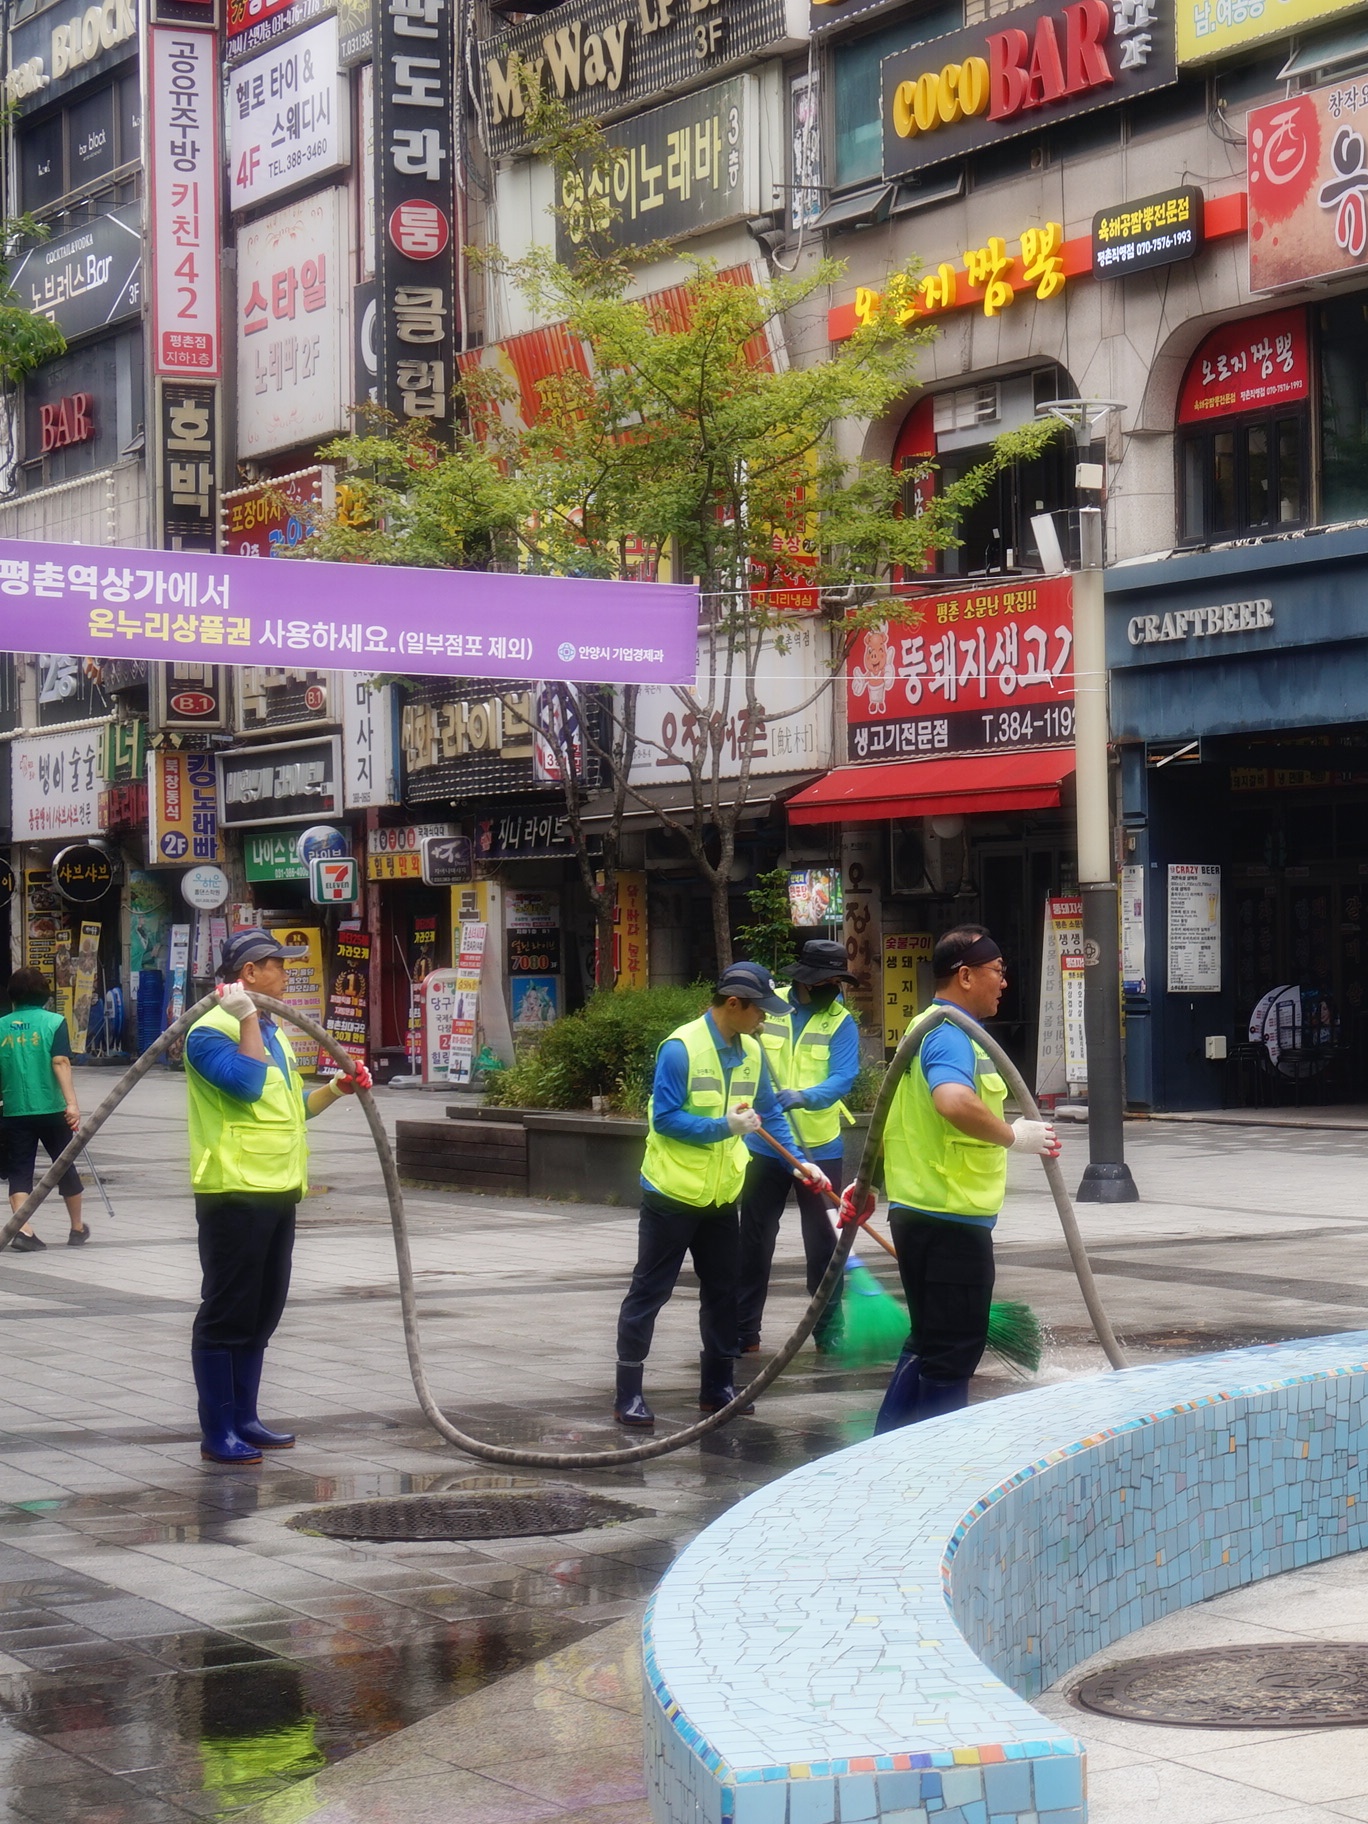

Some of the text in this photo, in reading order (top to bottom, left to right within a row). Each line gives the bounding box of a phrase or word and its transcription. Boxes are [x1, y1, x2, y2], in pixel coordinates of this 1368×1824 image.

[543, 19, 632, 99] Way
[694, 16, 722, 59] 3F
[236, 73, 266, 120] 헬로
[270, 54, 298, 100] 타이
[892, 0, 1115, 138] COCO BAR
[270, 87, 331, 148] 스웨디시
[168, 41, 200, 319] 공유주방 키친42
[236, 144, 260, 190] 4F
[399, 206, 440, 252] 룸
[1098, 196, 1190, 242] 육해공짬뽕전문점
[1097, 230, 1192, 267] 평촌직영점 070-7576-1993
[128, 282, 140, 305] 3F
[243, 252, 327, 336] 스타일
[166, 352, 210, 365] 지하1층
[169, 335, 207, 349] 평촌점
[1202, 332, 1294, 386] 오로지 짬뽕
[40, 392, 95, 452] BAR
[0, 559, 230, 609] 평촌역상가에서
[936, 589, 1037, 624] 평촌 소문난 맛집!!
[88, 608, 534, 661] 온누리상품권 사용하세요. (일부점포 제외)
[1127, 598, 1274, 646] CRAFTBEER
[578, 645, 665, 663] 안양시 기업경제과
[854, 718, 949, 756] 생고기전문점
[165, 759, 180, 820] 북창동식
[163, 833, 187, 855] 2F
[253, 838, 287, 866] 나이스
[59, 864, 110, 883] 샤브샤브
[1175, 865, 1220, 875] CRAZY BEER
[510, 954, 550, 970] 7080
[885, 936, 931, 950] 숯불구이
[886, 956, 898, 1041] 생고기
